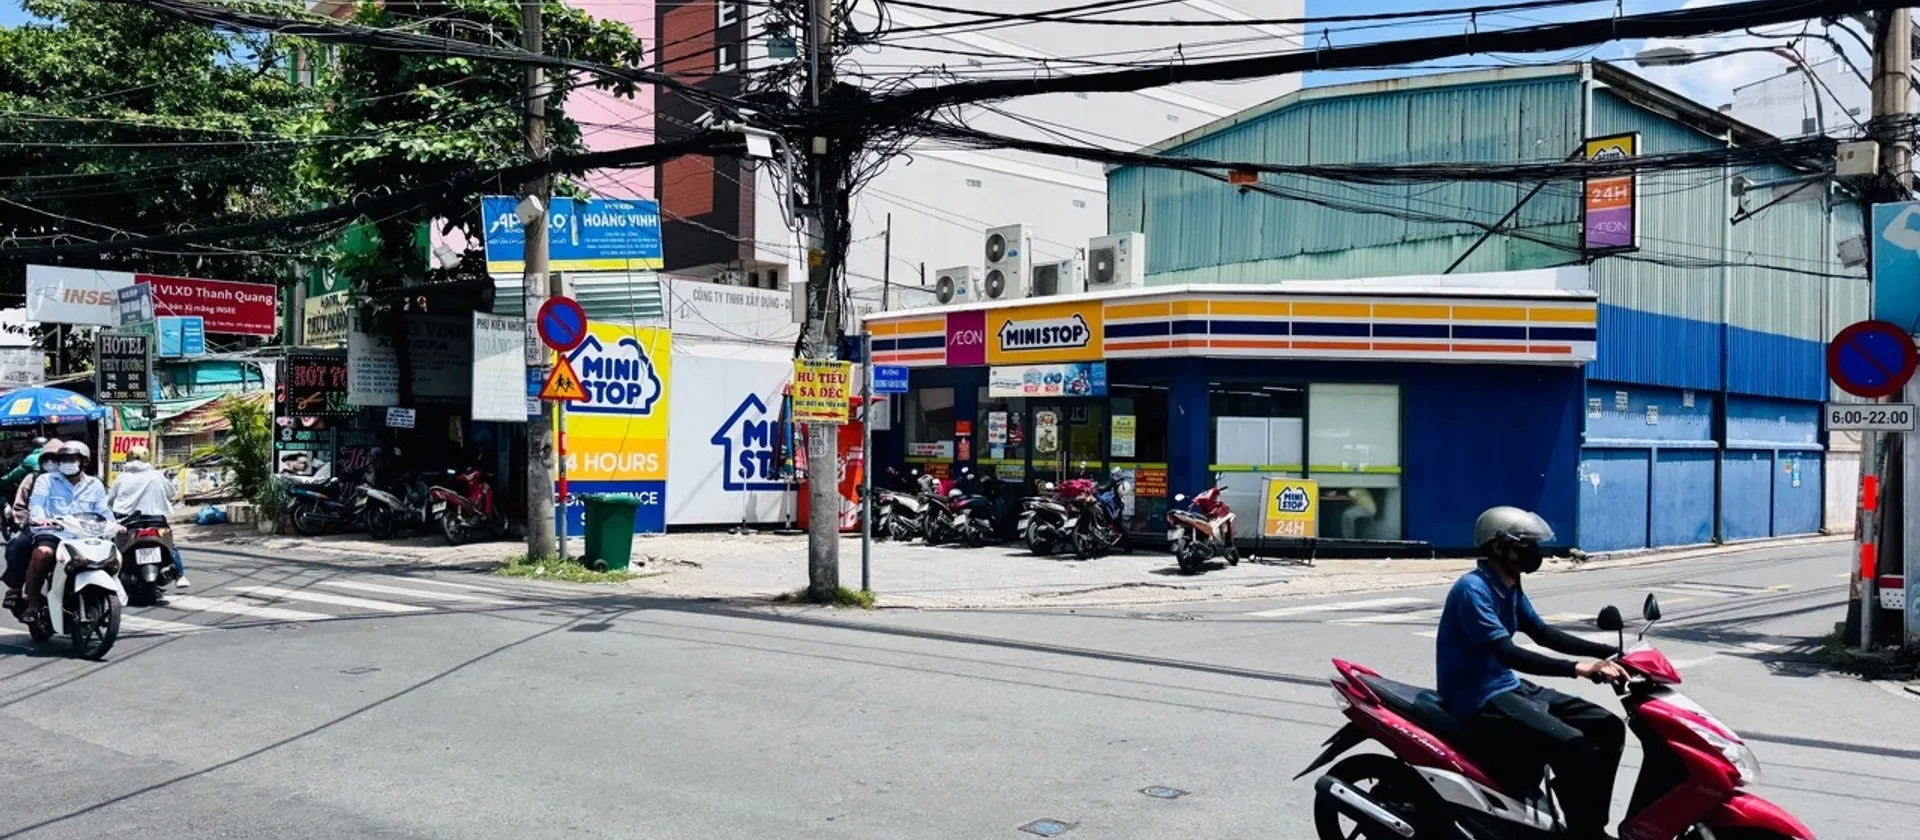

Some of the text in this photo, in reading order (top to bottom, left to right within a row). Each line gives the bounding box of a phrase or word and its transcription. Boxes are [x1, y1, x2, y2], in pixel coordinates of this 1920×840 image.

[1591, 185, 1627, 203] 24H
[583, 210, 657, 227] HOÀNG VINH
[160, 284, 194, 297] VLXD
[195, 287, 233, 300] Thanh
[234, 290, 274, 306] Quang
[692, 287, 713, 301] CÔNG
[713, 291, 724, 302] TY
[1006, 325, 1083, 346] MINISTOP
[102, 335, 145, 354] HOTEL
[582, 356, 640, 381] MINI
[818, 369, 848, 384] TIẾU
[580, 380, 642, 404] STOP
[800, 386, 815, 397] SA
[1832, 410, 1908, 424] 6:00-22:00
[584, 452, 659, 472] HOURS
[1282, 501, 1304, 509] STOP
[1283, 493, 1304, 501] MINI
[1275, 520, 1305, 535] 24H
